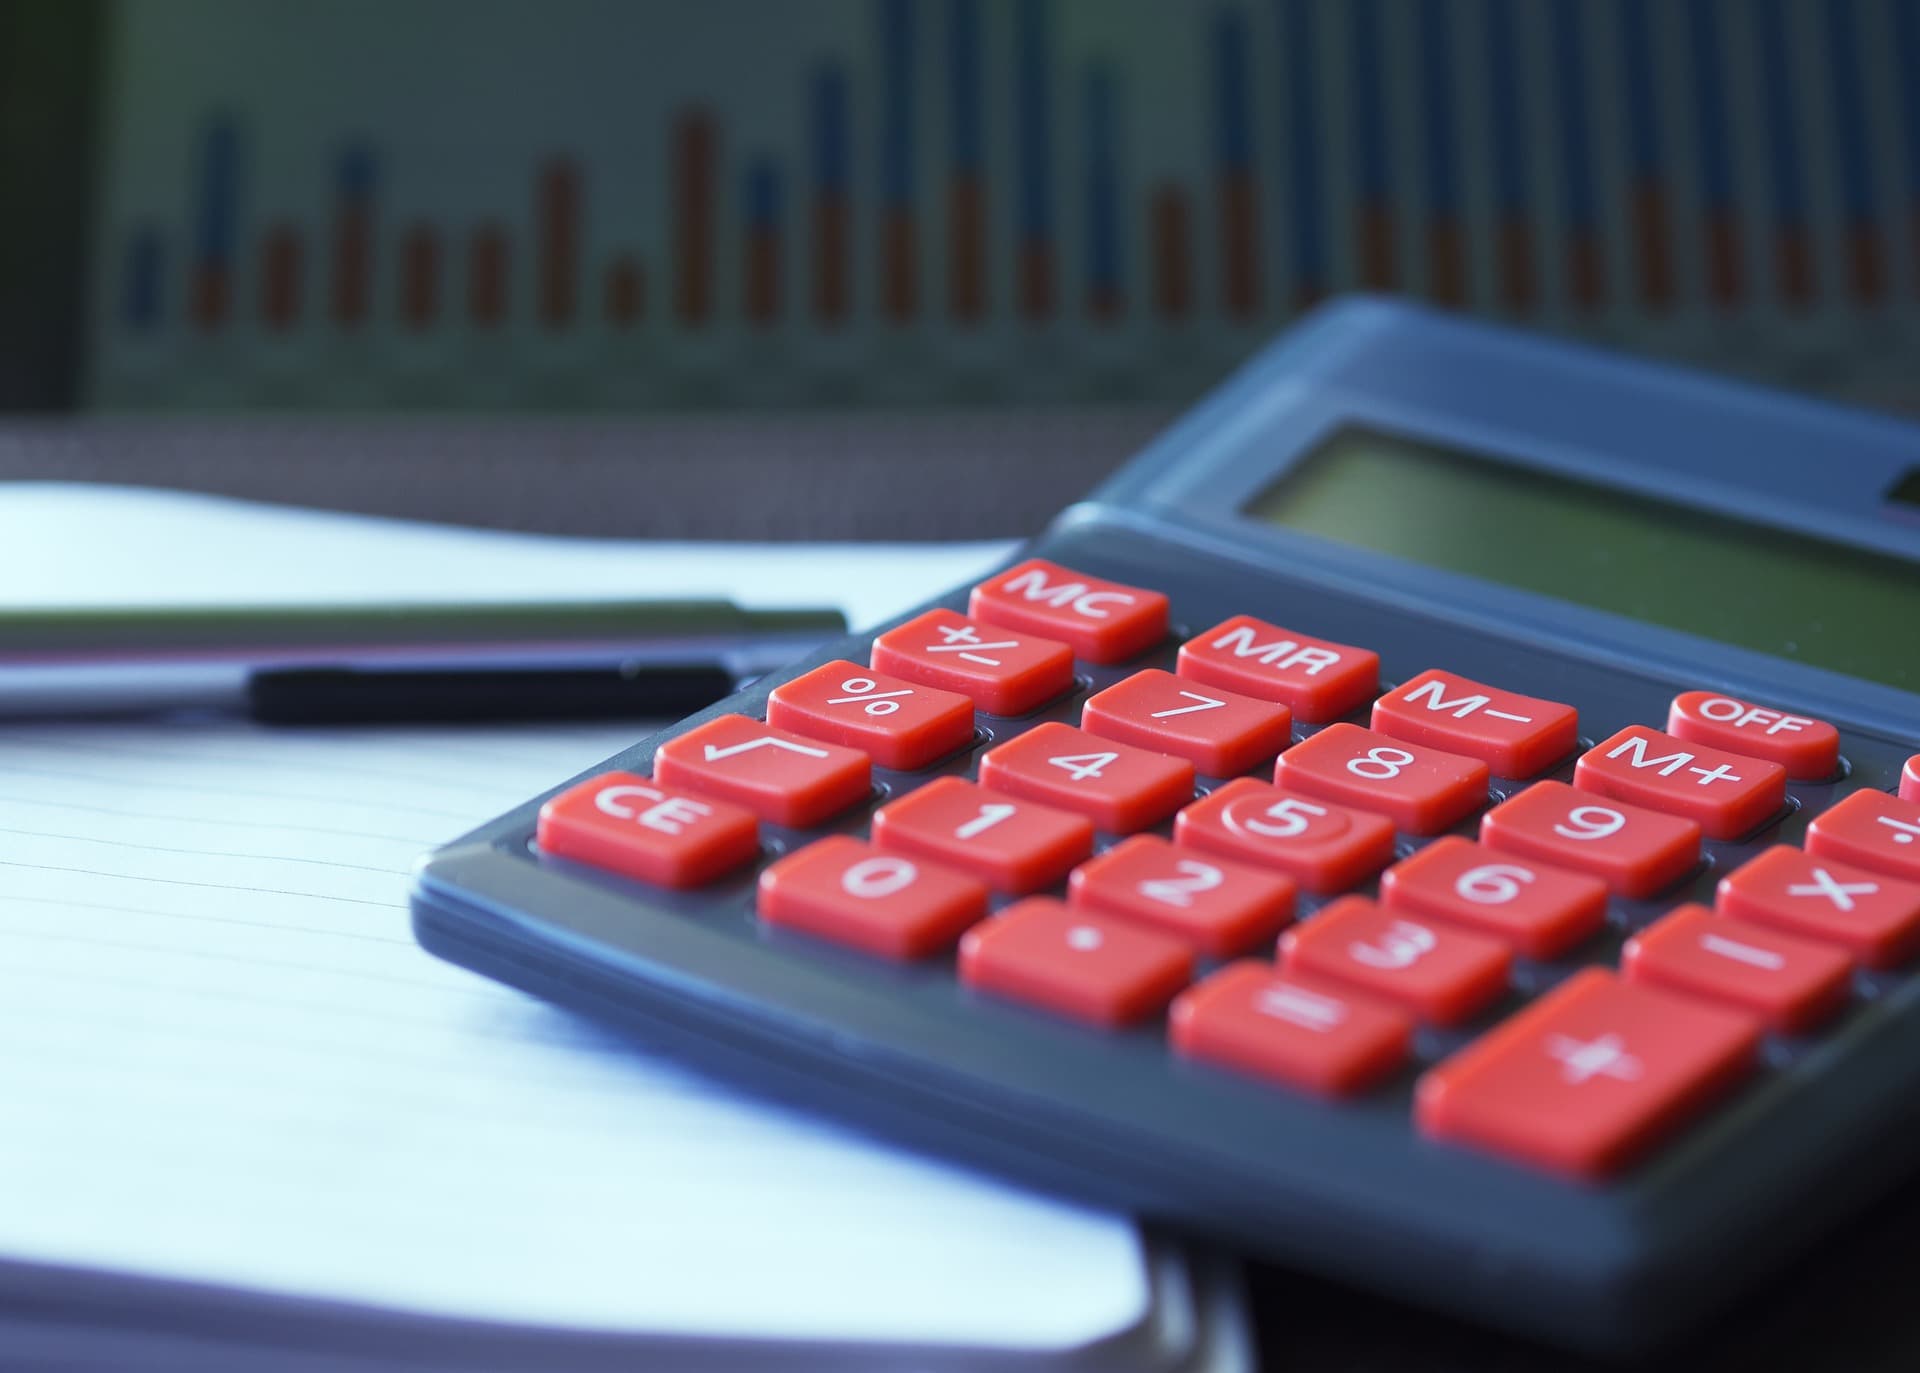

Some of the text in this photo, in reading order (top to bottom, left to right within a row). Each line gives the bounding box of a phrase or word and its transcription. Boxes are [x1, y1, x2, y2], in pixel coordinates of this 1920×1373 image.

[1004, 570, 1135, 618] MC
[927, 623, 1019, 667] +/-
[1212, 626, 1341, 675] MR
[826, 678, 914, 716] %
[1150, 690, 1226, 718] 7
[1402, 680, 1533, 725] M-
[1698, 698, 1814, 738] OFF
[1048, 751, 1117, 781] 4
[1346, 746, 1415, 779] 8
[1605, 736, 1742, 786] M+
[595, 785, 711, 835] CE
[956, 803, 1016, 838] 1
[1245, 799, 1326, 838] 5
[1553, 805, 1625, 840] 9
[841, 856, 917, 897] 0
[1137, 860, 1224, 907] 2
[1455, 864, 1535, 905] 6
[1349, 921, 1438, 968] 3
